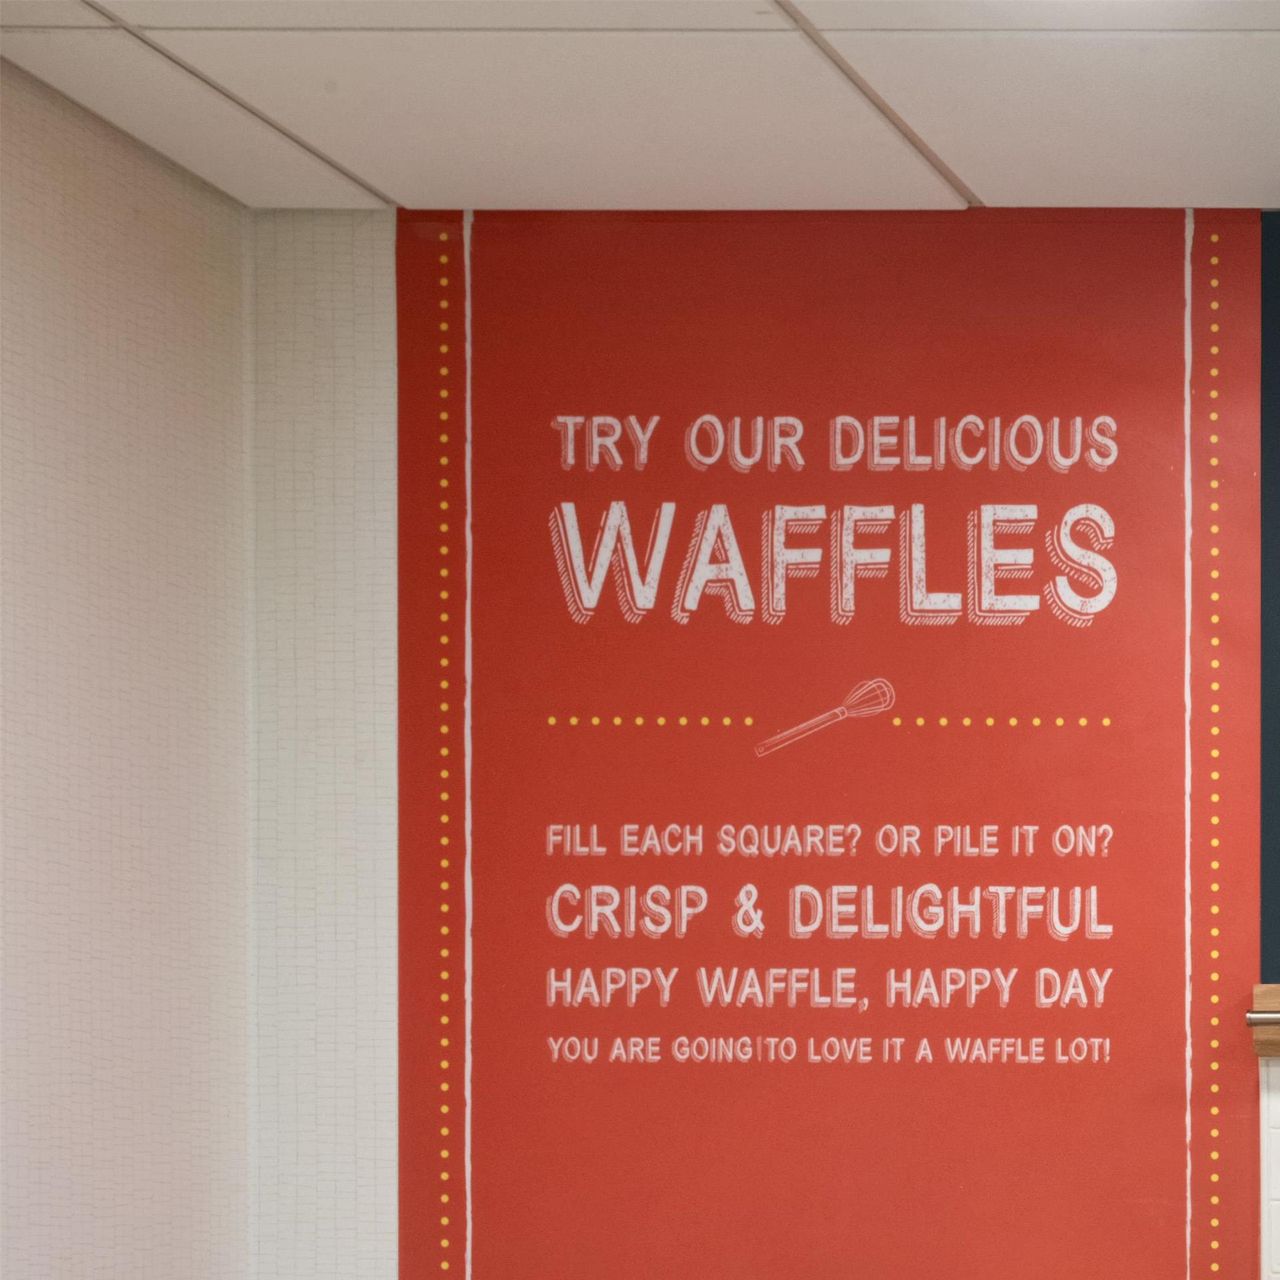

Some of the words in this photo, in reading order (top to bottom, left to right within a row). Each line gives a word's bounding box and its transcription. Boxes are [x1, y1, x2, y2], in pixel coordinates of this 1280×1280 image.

[551, 415, 660, 471] TRY
[685, 414, 805, 473] OUR
[830, 415, 1119, 474] DELICIOUS
[549, 501, 1118, 628] WAFFLES
[547, 824, 607, 856] FILL
[621, 824, 703, 856] EACH
[717, 824, 862, 857] SQUARE?
[876, 824, 921, 856] OR
[935, 825, 999, 856] PILE
[1012, 825, 1039, 856] IT
[1052, 824, 1114, 856] ON?
[546, 883, 708, 939] CRISP
[732, 883, 765, 938] &
[790, 883, 1113, 941] DELIGHTFUL
[547, 967, 679, 1007] HAPPY
[697, 967, 869, 1012] WAFFLE,
[887, 968, 1018, 1008] HAPPY
[1036, 968, 1113, 1008] DAY
[547, 1036, 598, 1063] YOU
[609, 1037, 661, 1062] ARE
[672, 1036, 752, 1062] GOING
[764, 1037, 797, 1062] TO
[808, 1037, 872, 1063] LOVE
[883, 1038, 905, 1063] IT
[915, 1038, 933, 1063] A
[945, 1038, 1045, 1063] WAFFLE
[1056, 1037, 1110, 1063] LOT!
